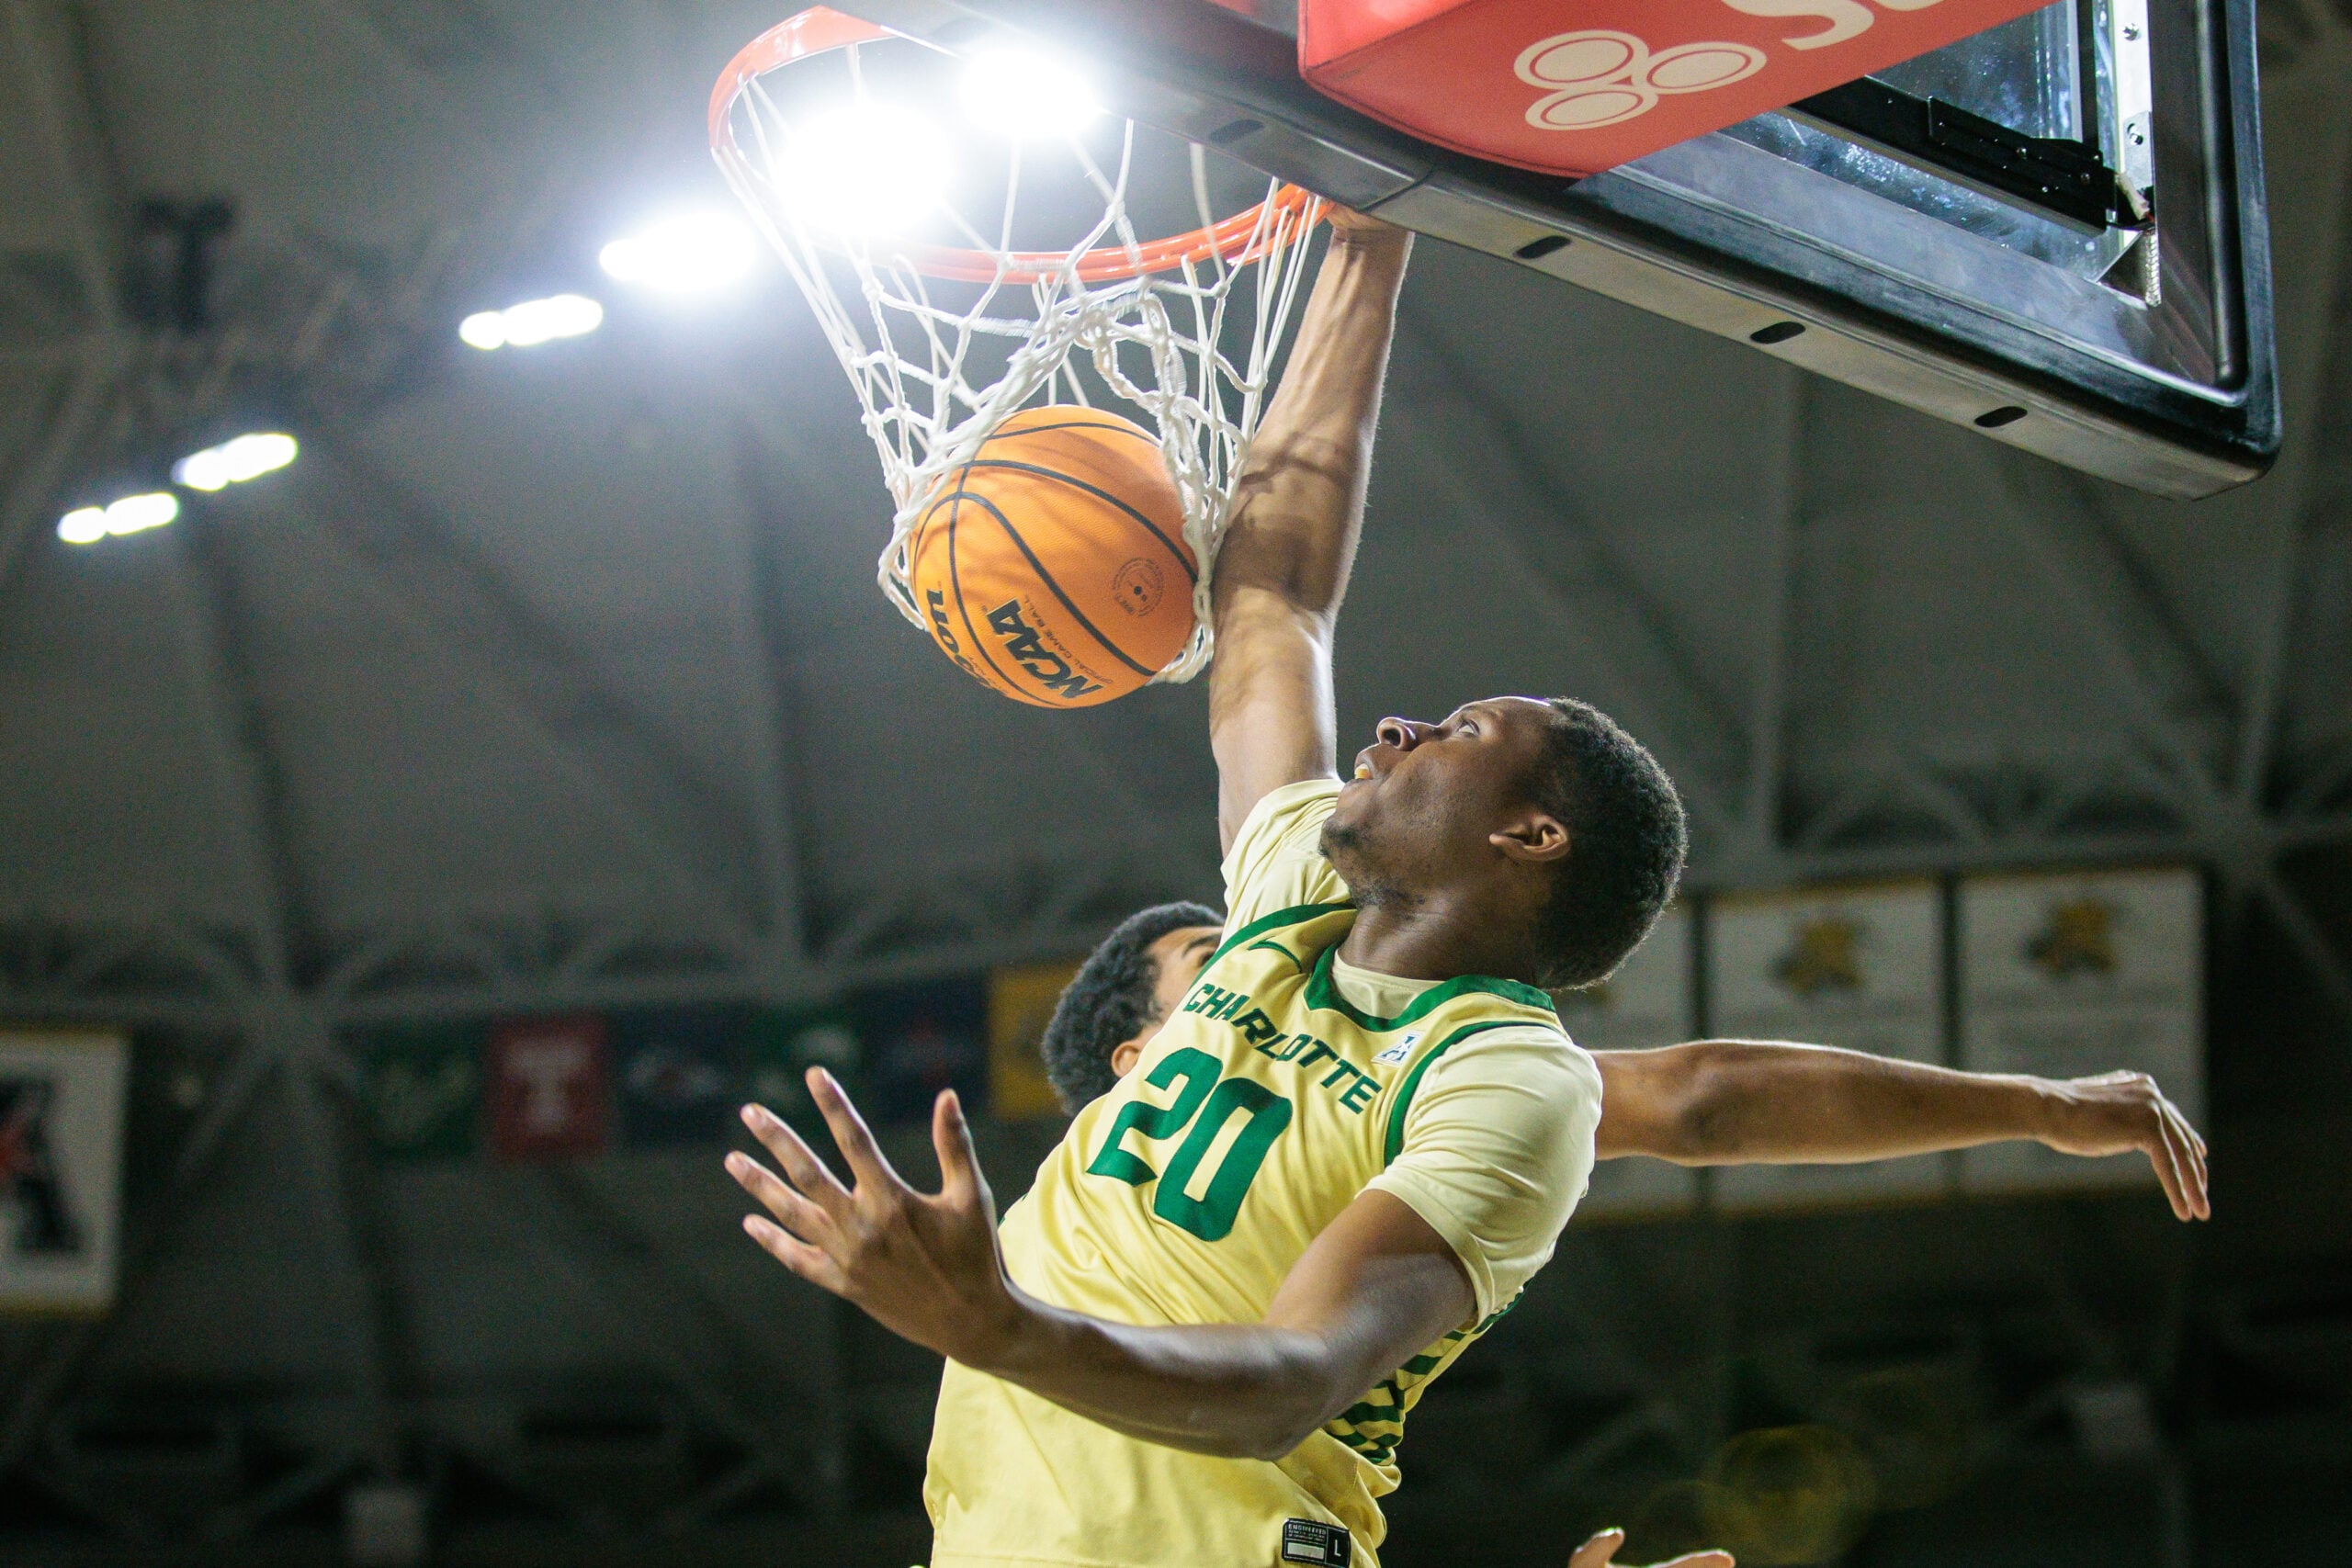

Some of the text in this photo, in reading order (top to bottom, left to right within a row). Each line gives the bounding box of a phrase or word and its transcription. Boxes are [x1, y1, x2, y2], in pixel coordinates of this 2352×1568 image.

[1024, 592, 1046, 628] BALL
[1044, 629, 1072, 659] GAME
[986, 597, 1104, 698] NCAA
[1182, 983, 1383, 1115] CHARLOTTE
[1086, 1046, 1293, 1243] 20
[1334, 1539, 1341, 1557] L
